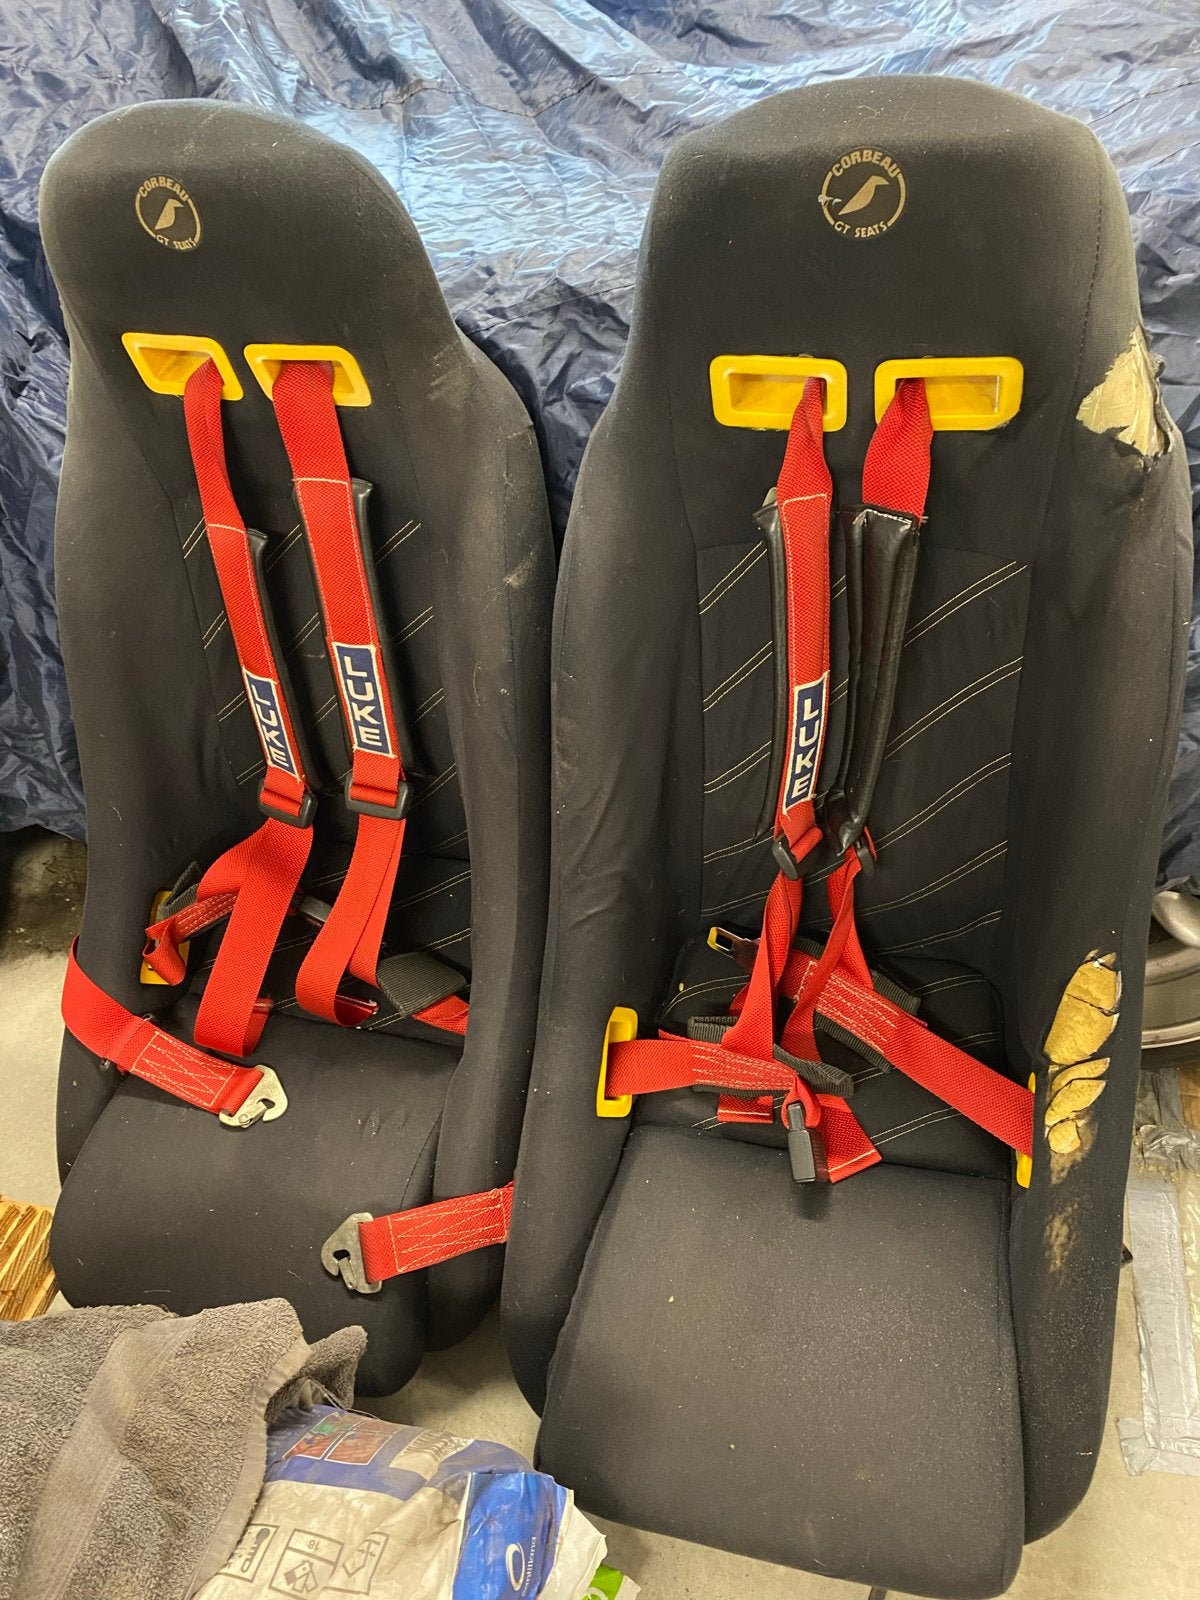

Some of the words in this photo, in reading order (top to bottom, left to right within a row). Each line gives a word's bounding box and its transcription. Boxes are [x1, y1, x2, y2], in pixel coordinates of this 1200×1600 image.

[832, 149, 901, 178] CORBEAU
[139, 176, 190, 202] CORBEAU
[156, 234, 170, 246] GT
[173, 237, 197, 250] SEATS
[834, 221, 851, 234] GT
[854, 221, 888, 238] SEATS
[343, 655, 382, 747] LUKE
[251, 684, 290, 768] LUKE
[791, 698, 820, 799] LUKE
